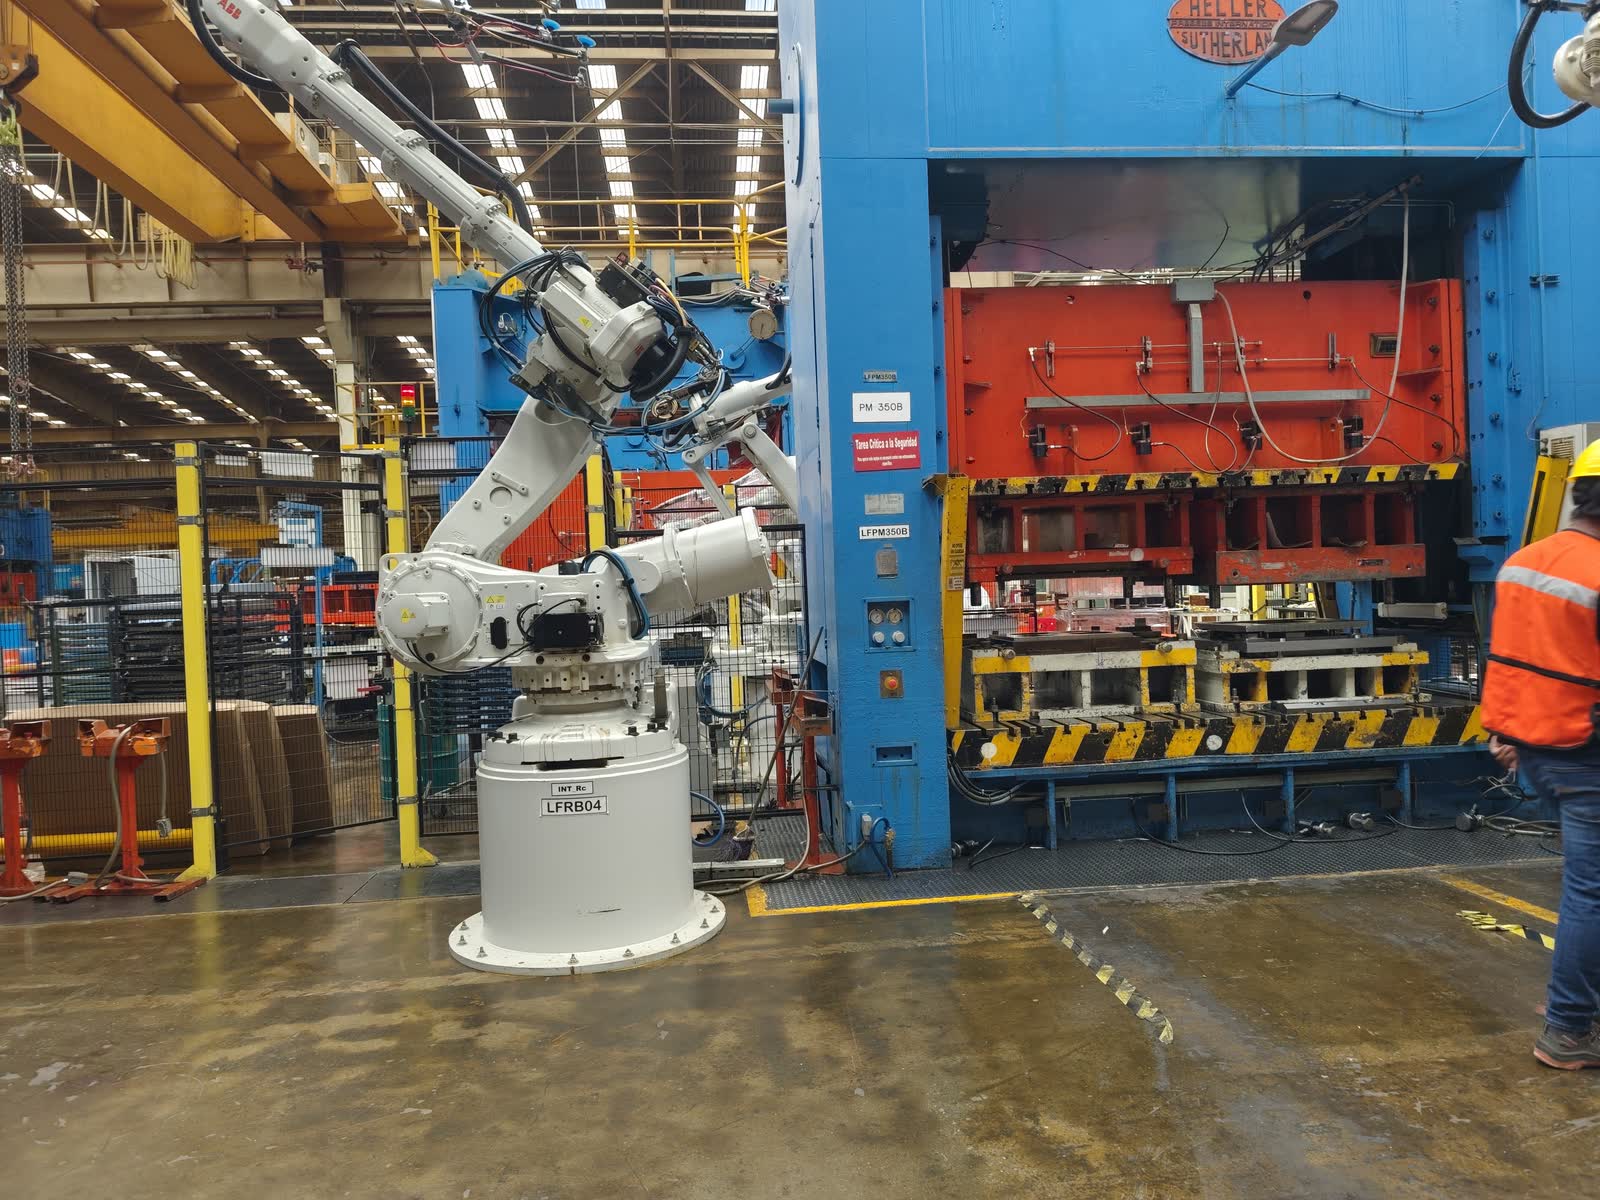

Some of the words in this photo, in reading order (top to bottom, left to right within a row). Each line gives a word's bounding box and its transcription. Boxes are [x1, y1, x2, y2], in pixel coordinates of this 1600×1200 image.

[218, 0, 242, 19] ABB
[1189, 0, 1267, 17] HELLER
[1181, 31, 1272, 58] SUTHERLAN
[859, 403, 873, 412] PM
[878, 402, 904, 412] 350B
[855, 439, 869, 450] Tarea
[889, 437, 894, 448] la
[895, 436, 918, 450] Seguridad
[861, 527, 908, 537] LFPM350B
[547, 799, 602, 813] LFRB04
